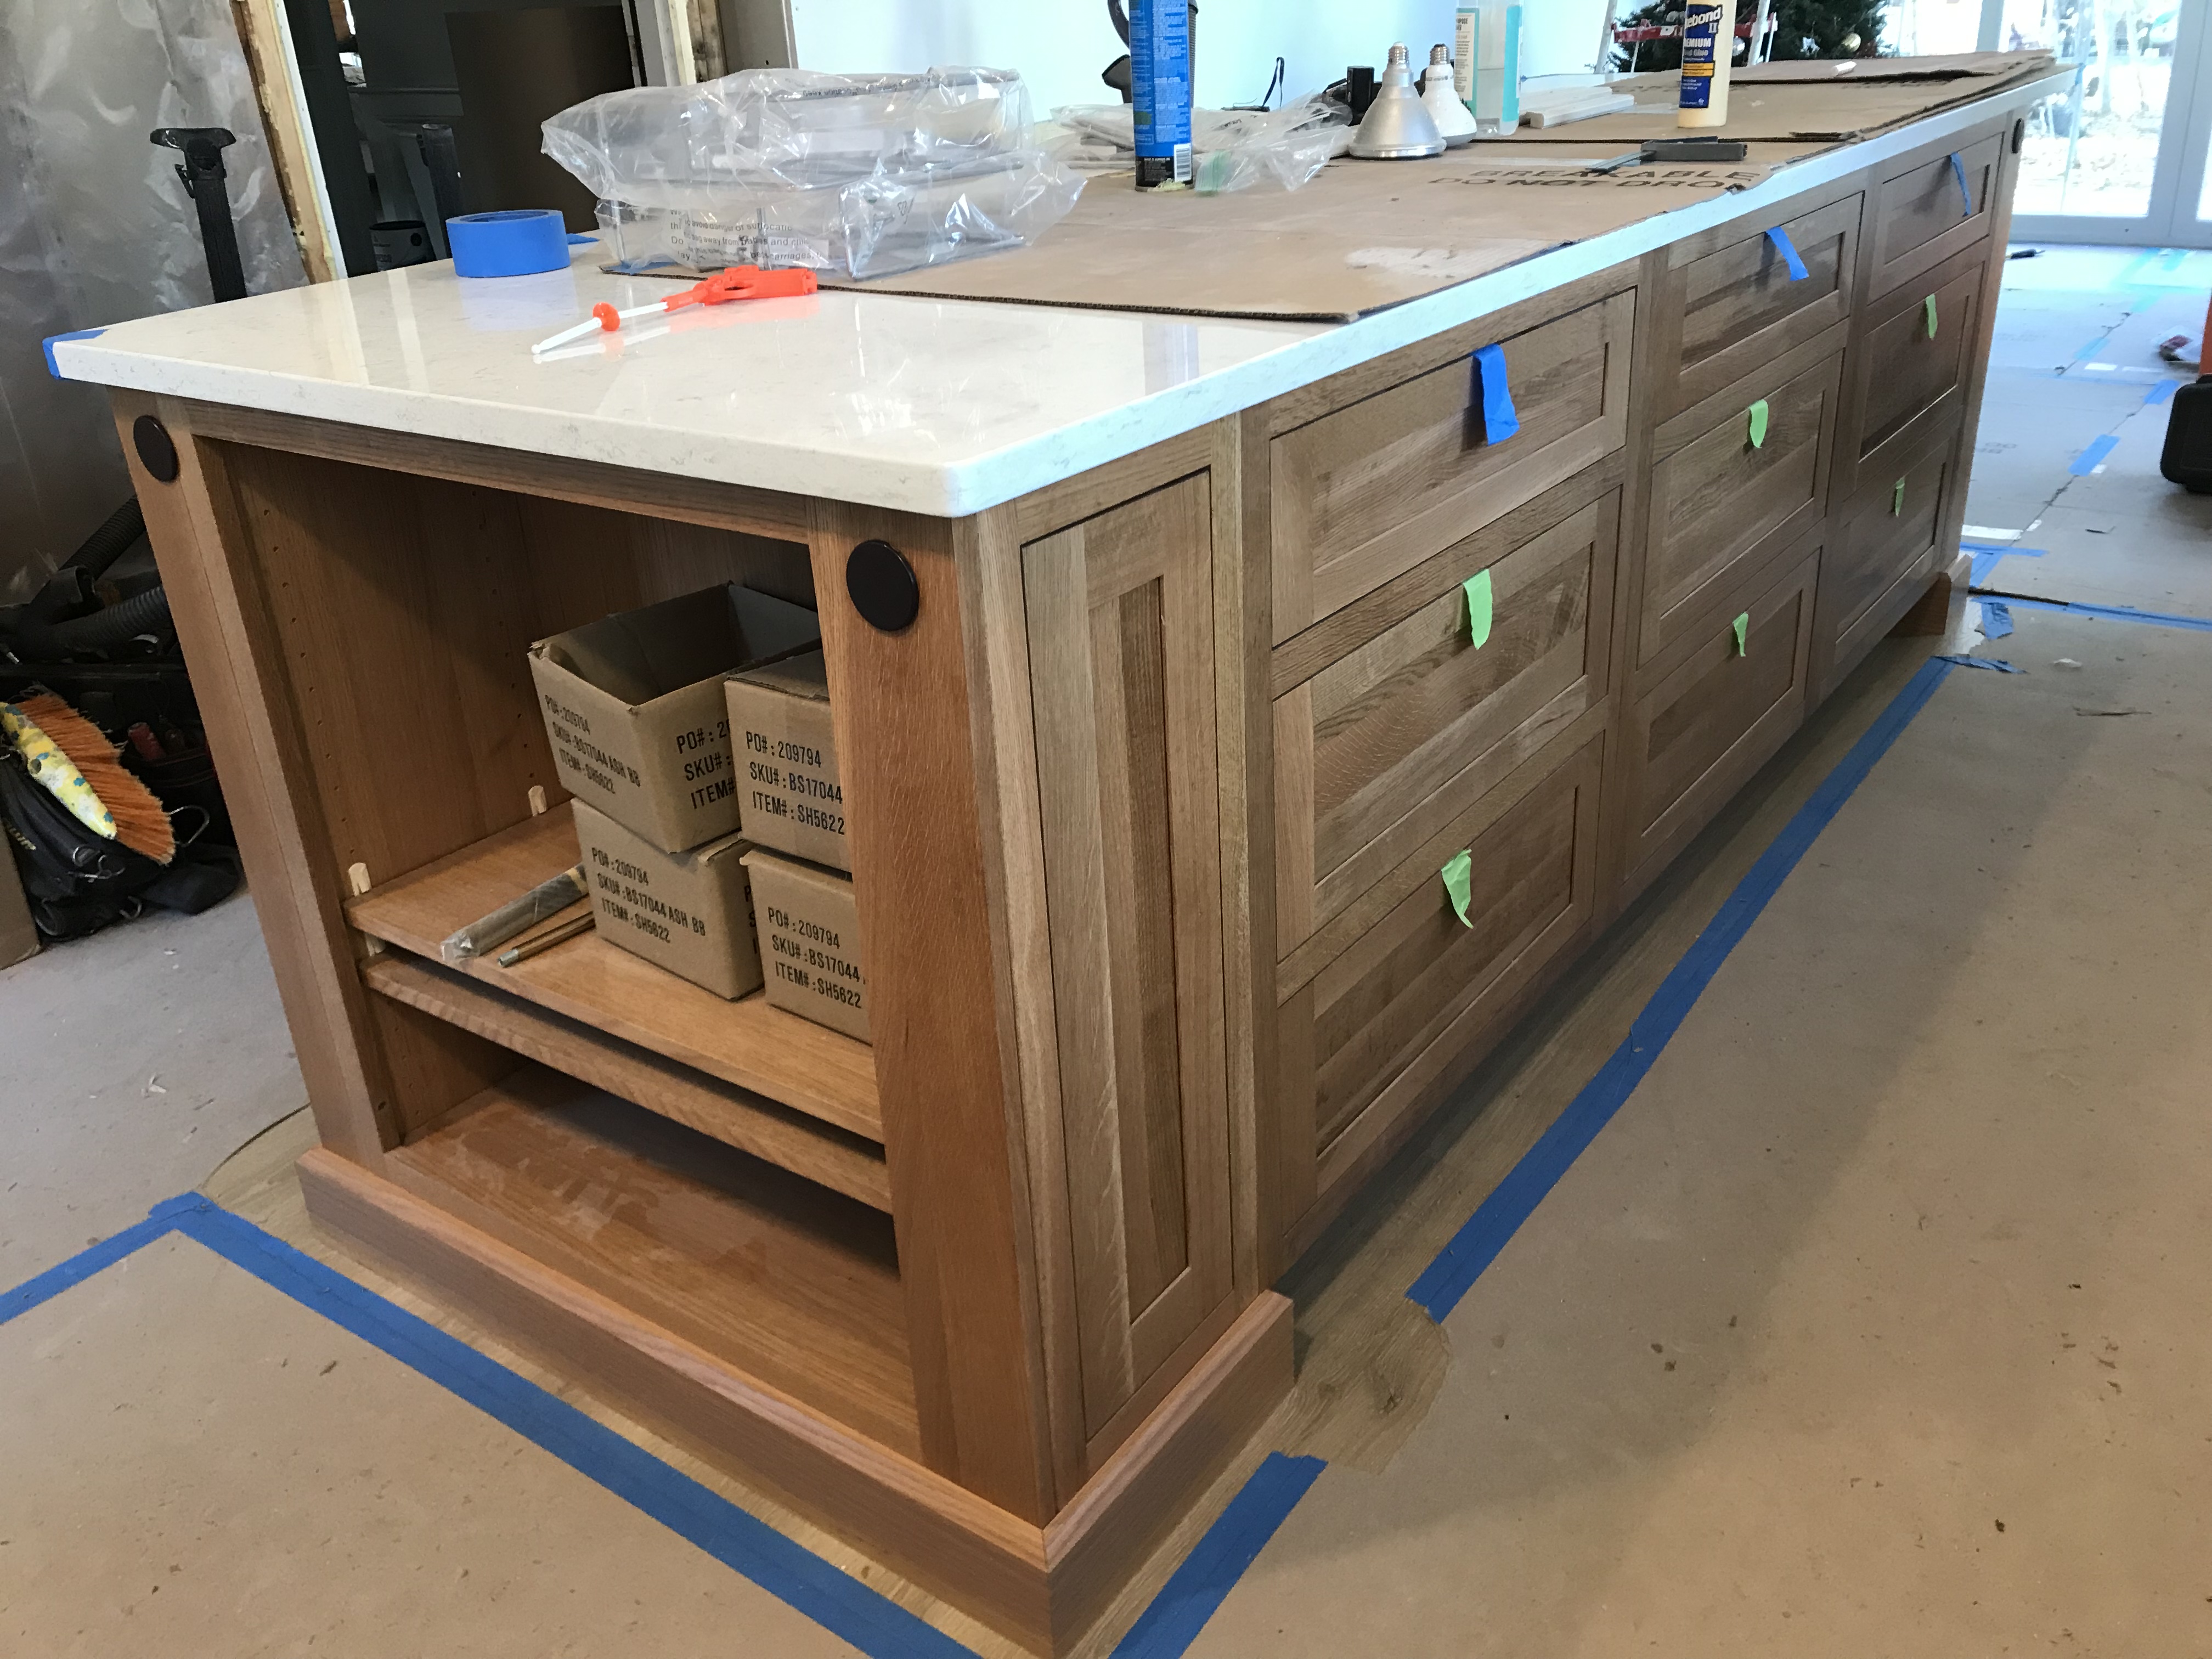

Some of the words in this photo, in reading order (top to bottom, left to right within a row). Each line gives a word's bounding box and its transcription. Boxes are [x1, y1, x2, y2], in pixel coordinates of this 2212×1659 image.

[1708, 22, 1718, 33] II
[1470, 170, 1760, 182] BREAKABLE
[1616, 180, 1726, 188] DRO
[770, 237, 788, 246] and
[668, 906, 688, 928] ASH
